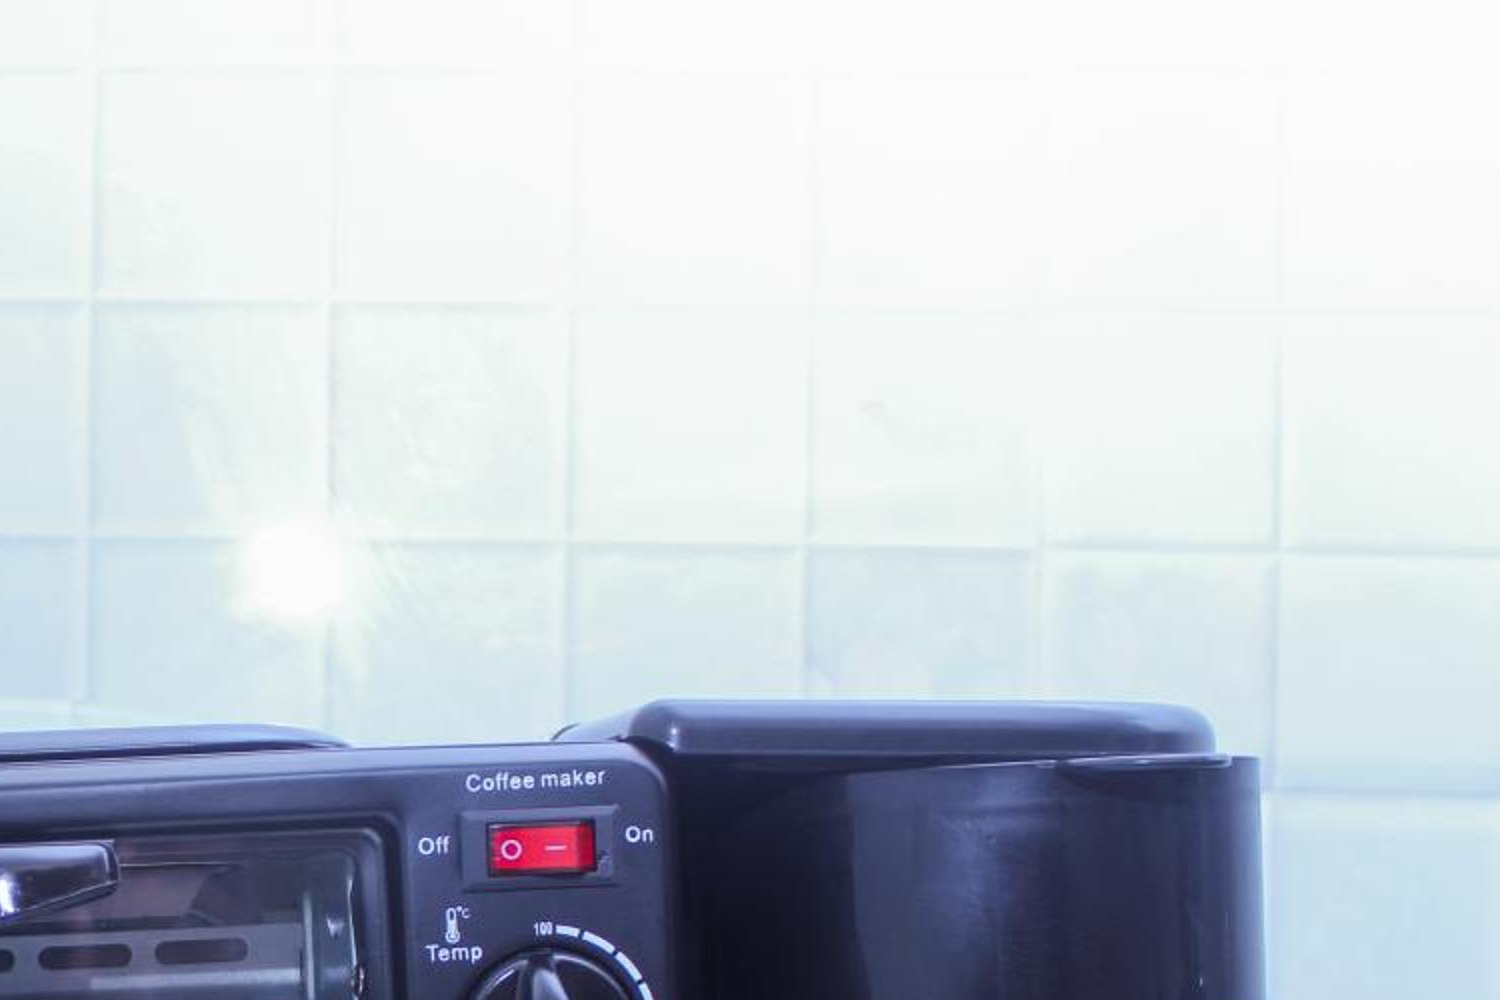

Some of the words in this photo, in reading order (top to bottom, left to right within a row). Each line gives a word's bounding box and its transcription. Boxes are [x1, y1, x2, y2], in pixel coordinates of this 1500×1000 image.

[465, 771, 535, 792] Coffee
[541, 769, 605, 787] maker
[625, 826, 654, 843] On
[417, 835, 450, 855] Off
[533, 921, 553, 936] 100
[425, 944, 483, 964] Temp
